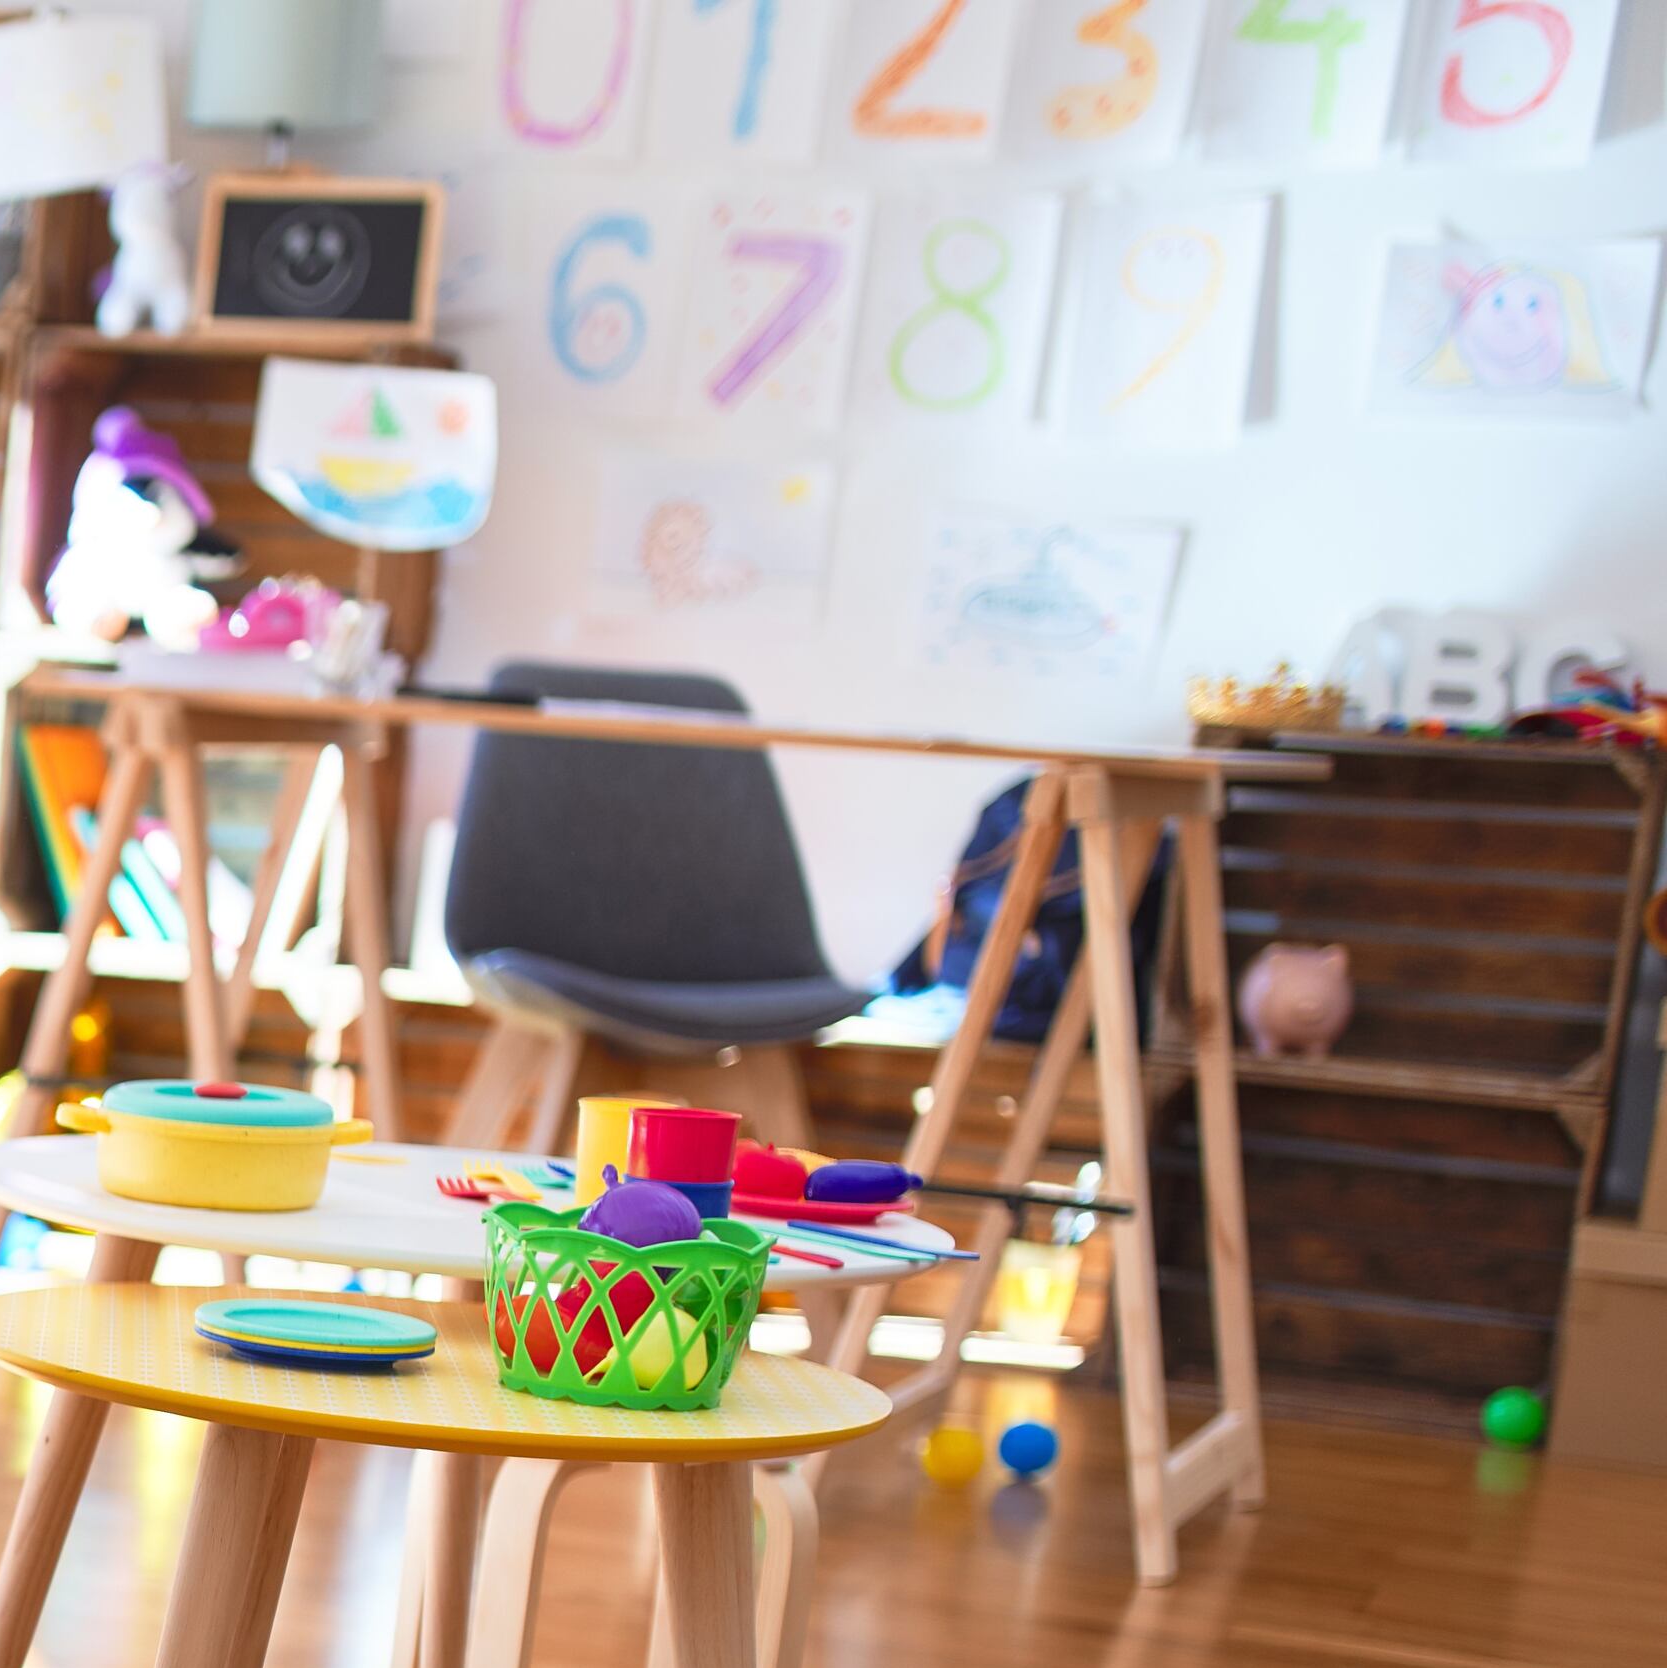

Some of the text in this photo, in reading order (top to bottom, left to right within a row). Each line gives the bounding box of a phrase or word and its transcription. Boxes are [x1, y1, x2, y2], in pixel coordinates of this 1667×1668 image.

[850, 0, 989, 140] 2
[1043, 0, 1159, 141] 3
[1234, 0, 1366, 140] 4
[1440, 0, 1573, 128] 5
[545, 213, 1224, 414] 6 7 8 9
